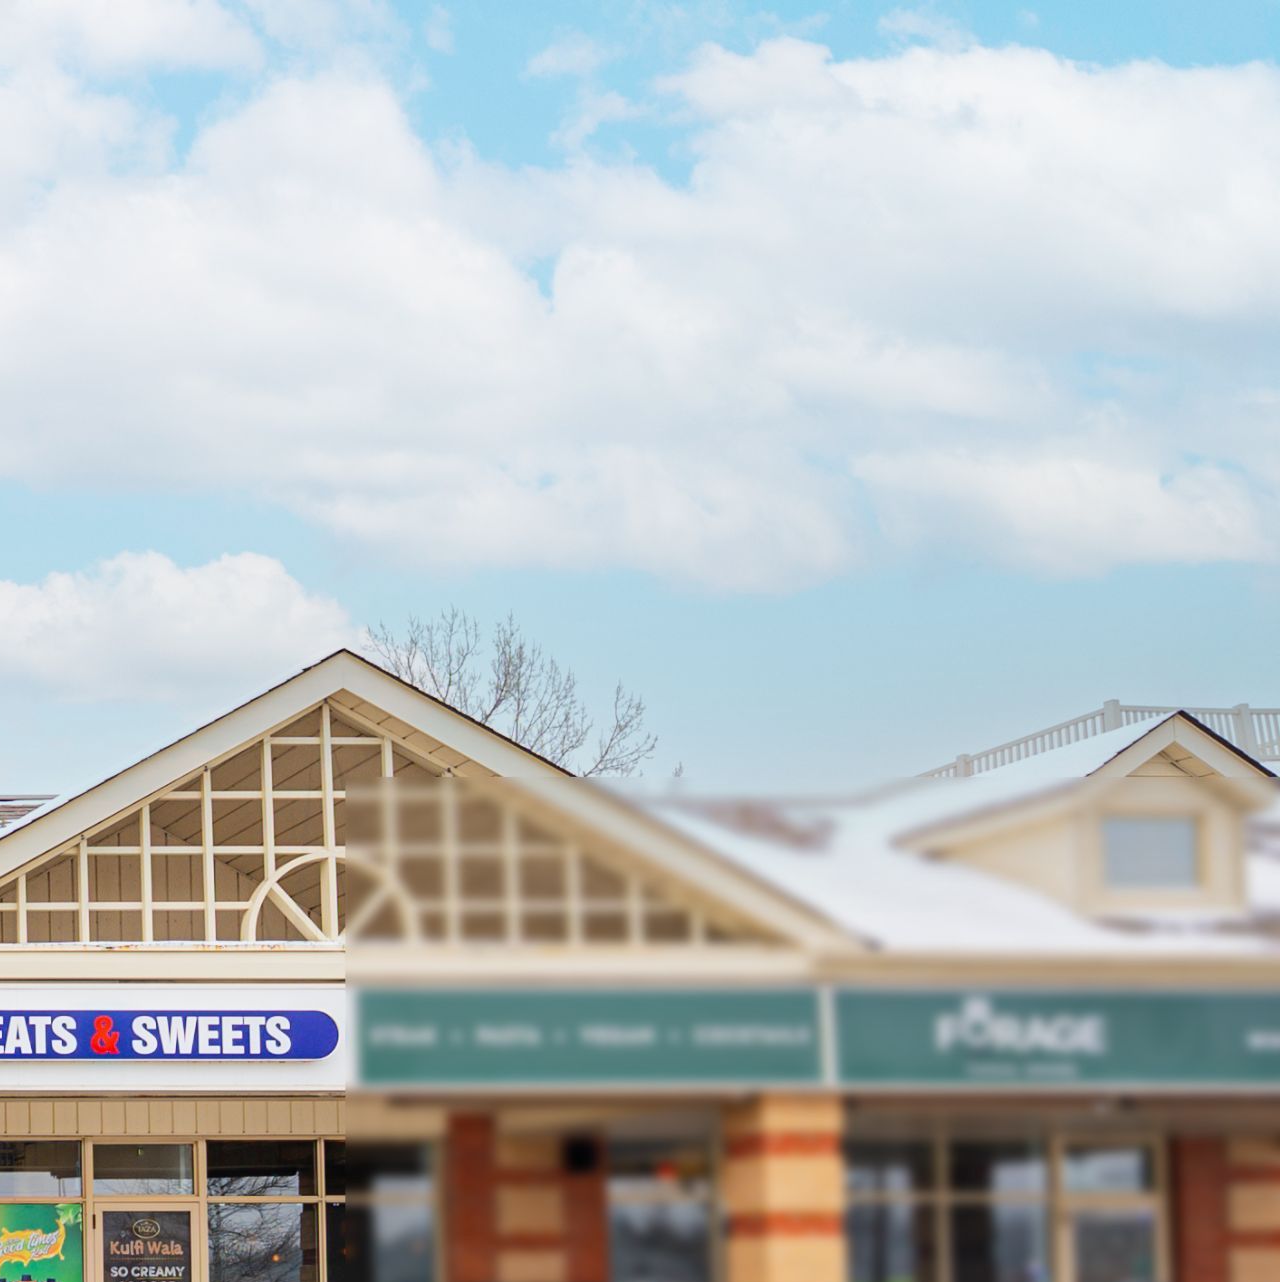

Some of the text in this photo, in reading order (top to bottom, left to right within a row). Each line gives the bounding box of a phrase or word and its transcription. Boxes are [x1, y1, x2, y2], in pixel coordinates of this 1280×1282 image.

[90, 1014, 120, 1055] &
[131, 1014, 292, 1055] SWEETS
[110, 1240, 184, 1256] Kulfi Wala
[110, 1265, 185, 1278] SO CREAMY
